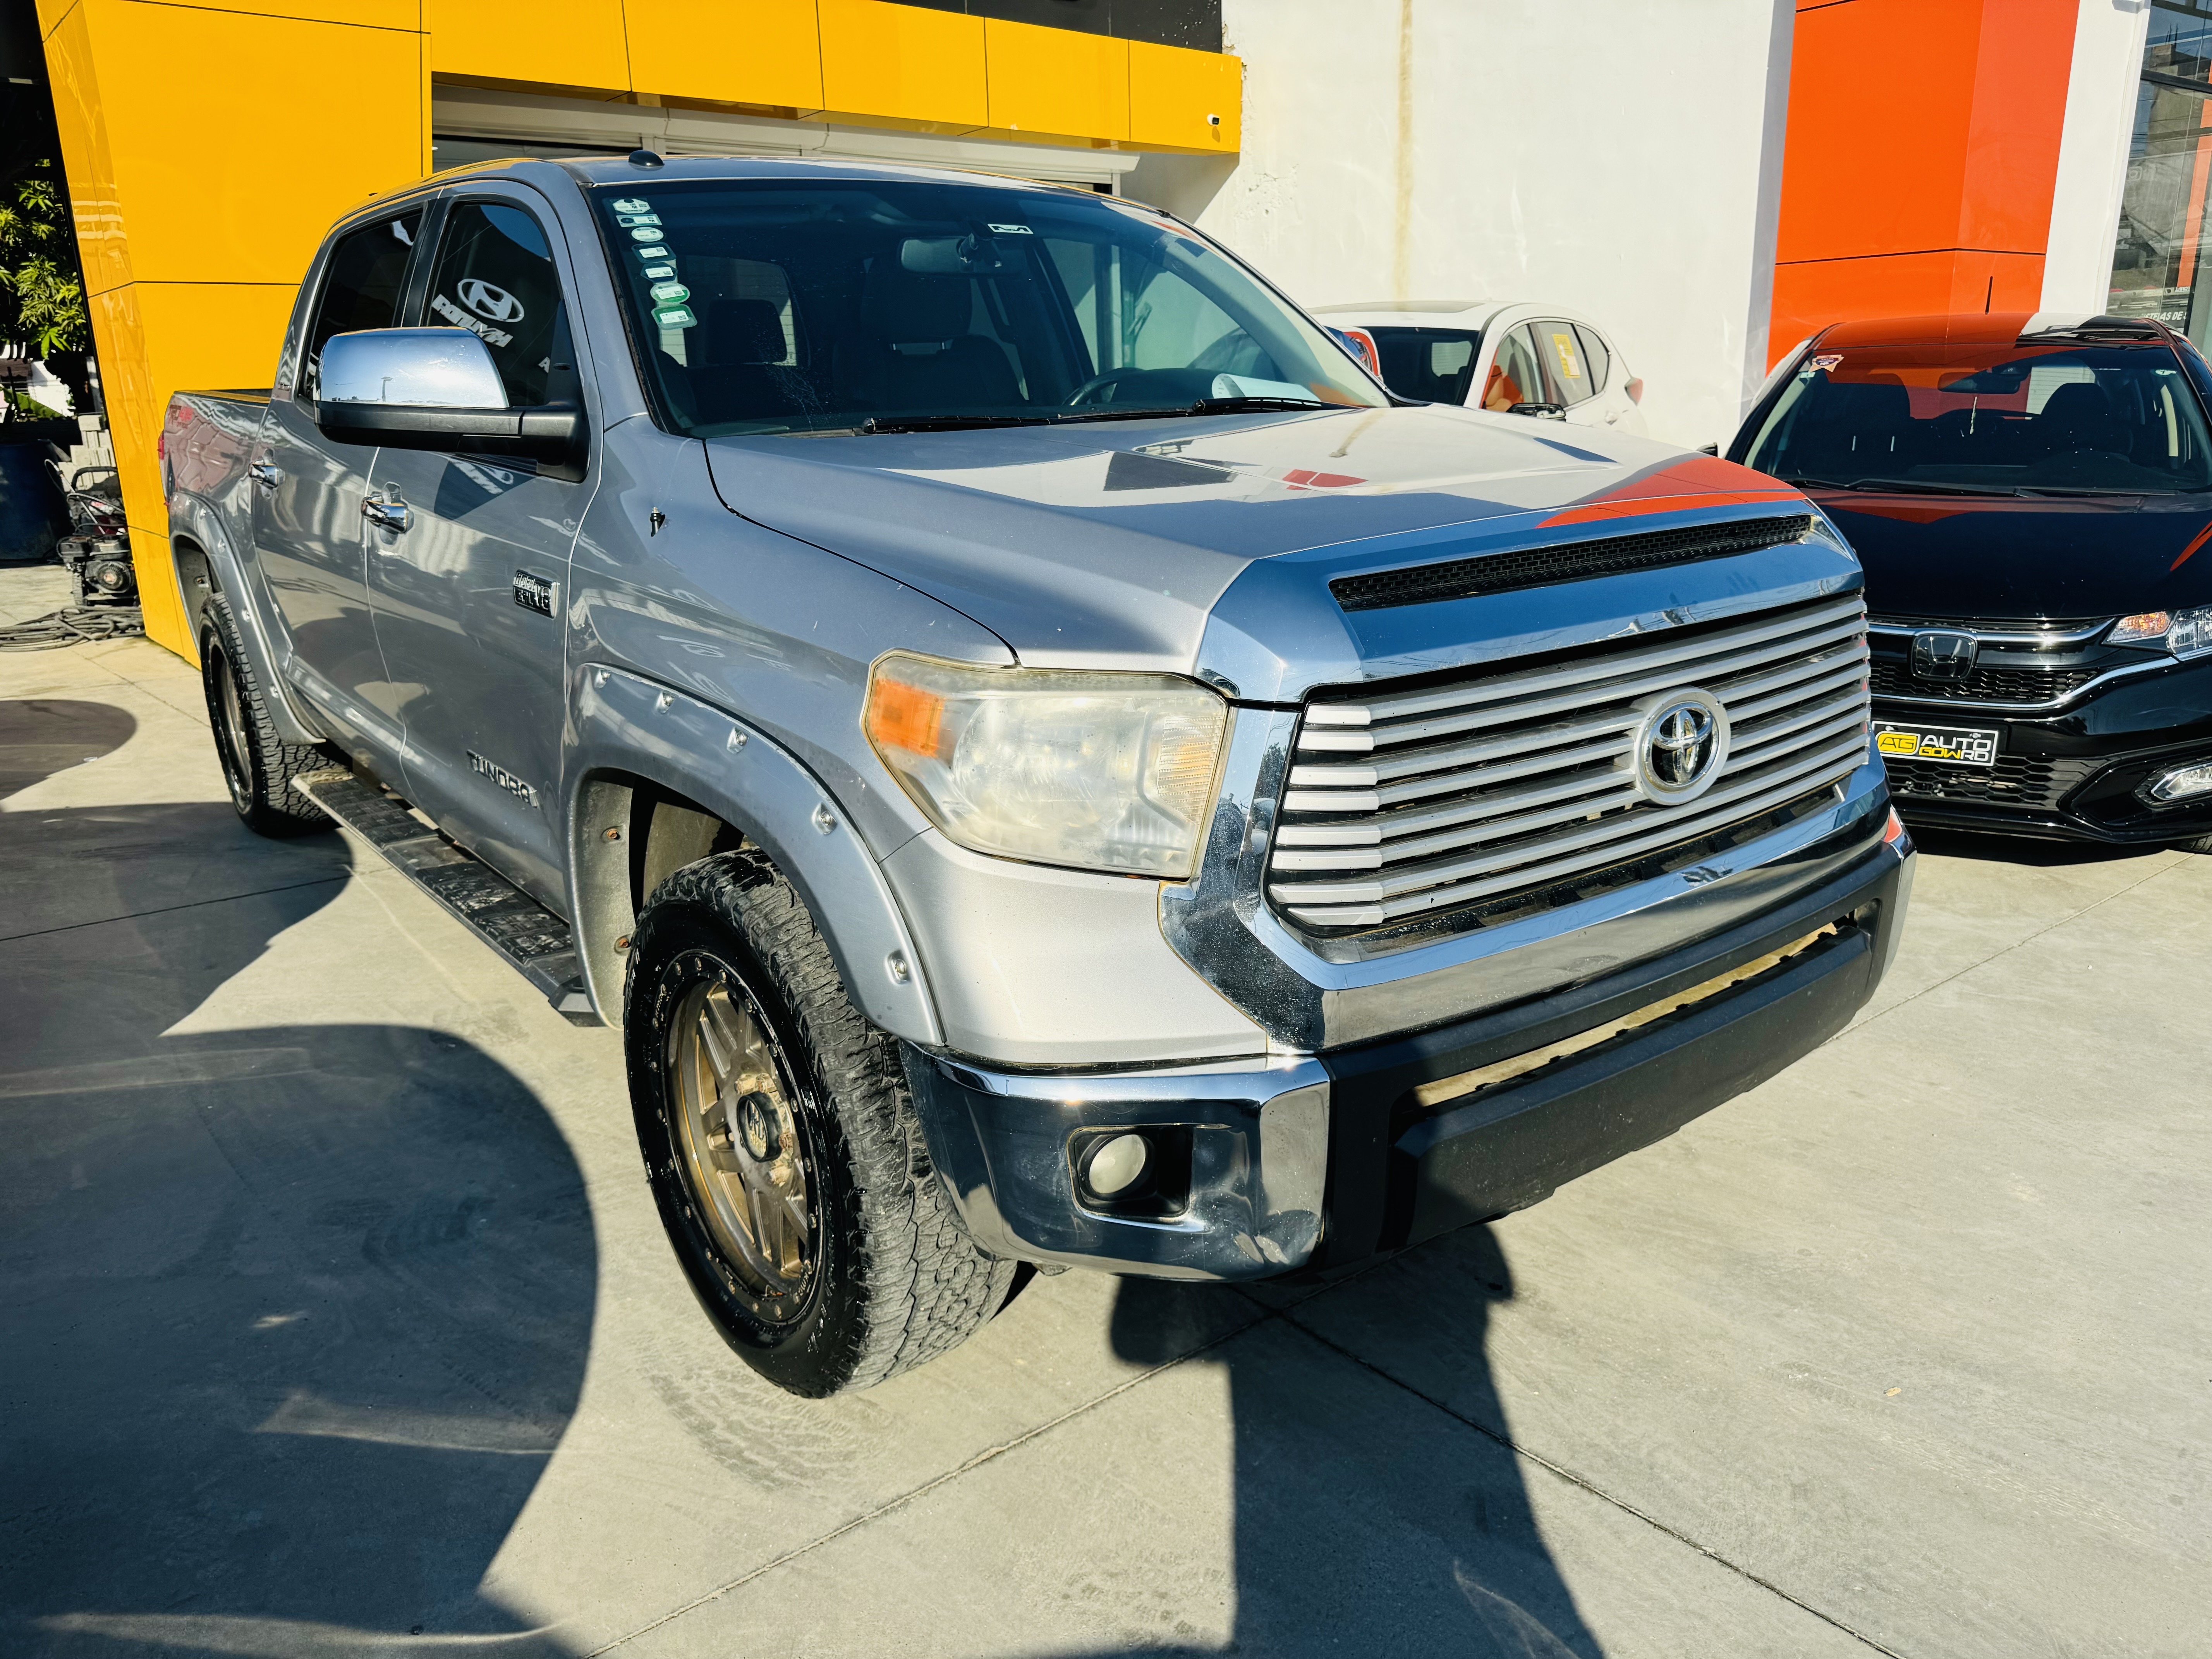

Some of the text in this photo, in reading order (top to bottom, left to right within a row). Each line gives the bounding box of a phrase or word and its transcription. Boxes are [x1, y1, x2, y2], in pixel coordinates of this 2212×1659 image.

[2172, 311, 2183, 320] DE
[1921, 735, 1992, 752] AUTO
[467, 749, 539, 808] TUNDRA
